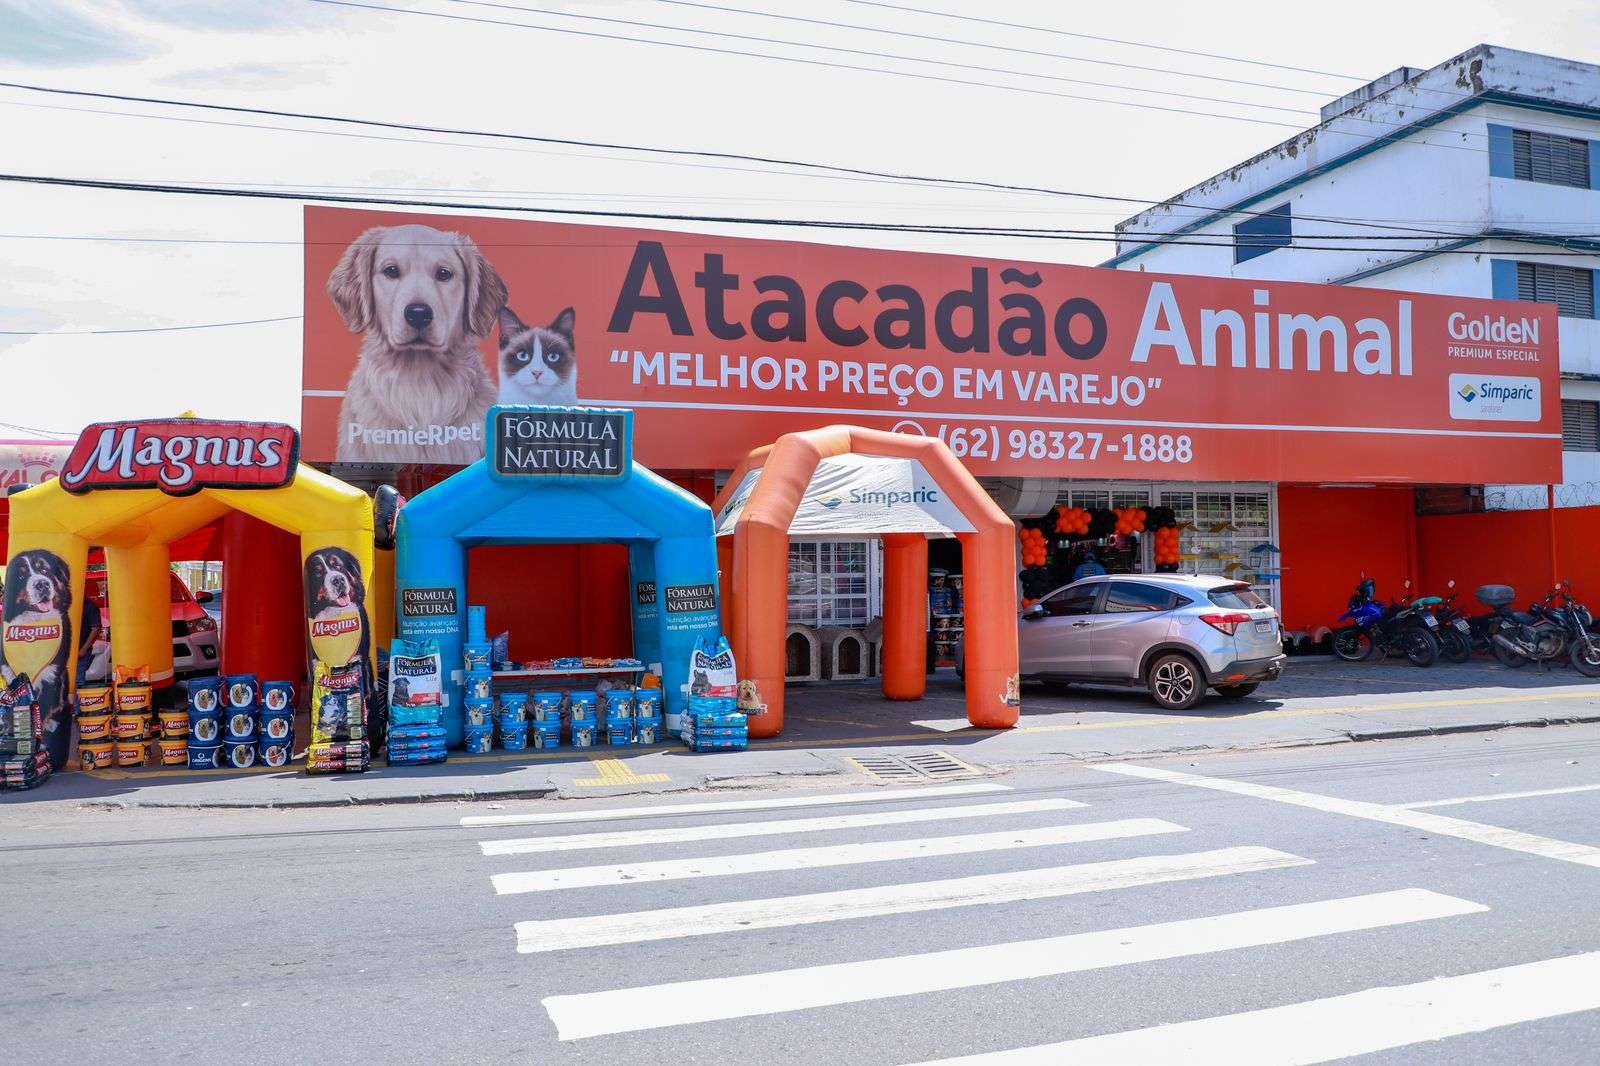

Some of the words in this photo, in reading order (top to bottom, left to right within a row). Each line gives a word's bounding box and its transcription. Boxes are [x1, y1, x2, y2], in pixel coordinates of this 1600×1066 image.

[606, 240, 1108, 360] Atacadão
[1130, 282, 1414, 376] Animal
[1448, 312, 1540, 345] GoldeN
[1448, 346, 1493, 359] PREMIUM
[1496, 349, 1540, 362] ESPECIAL
[818, 359, 944, 406] PREÇO
[953, 367, 1003, 400] EM
[1480, 383, 1533, 403] Simparic
[348, 422, 481, 446] PremieRpet
[503, 416, 618, 440] FÓRMULA
[65, 427, 283, 486] Magnus
[1008, 429, 1193, 463] 98327-1888
[503, 446, 618, 469] NATURAL
[849, 486, 938, 508] Simparic
[404, 589, 455, 601] FÓRMULA
[667, 587, 714, 599] FÓRMULA
[405, 603, 456, 615] NATURAL
[668, 598, 715, 611] NATURAL
[7, 625, 60, 642] Magnus
[313, 617, 358, 636] Magnus
[321, 674, 359, 688] Magnus
